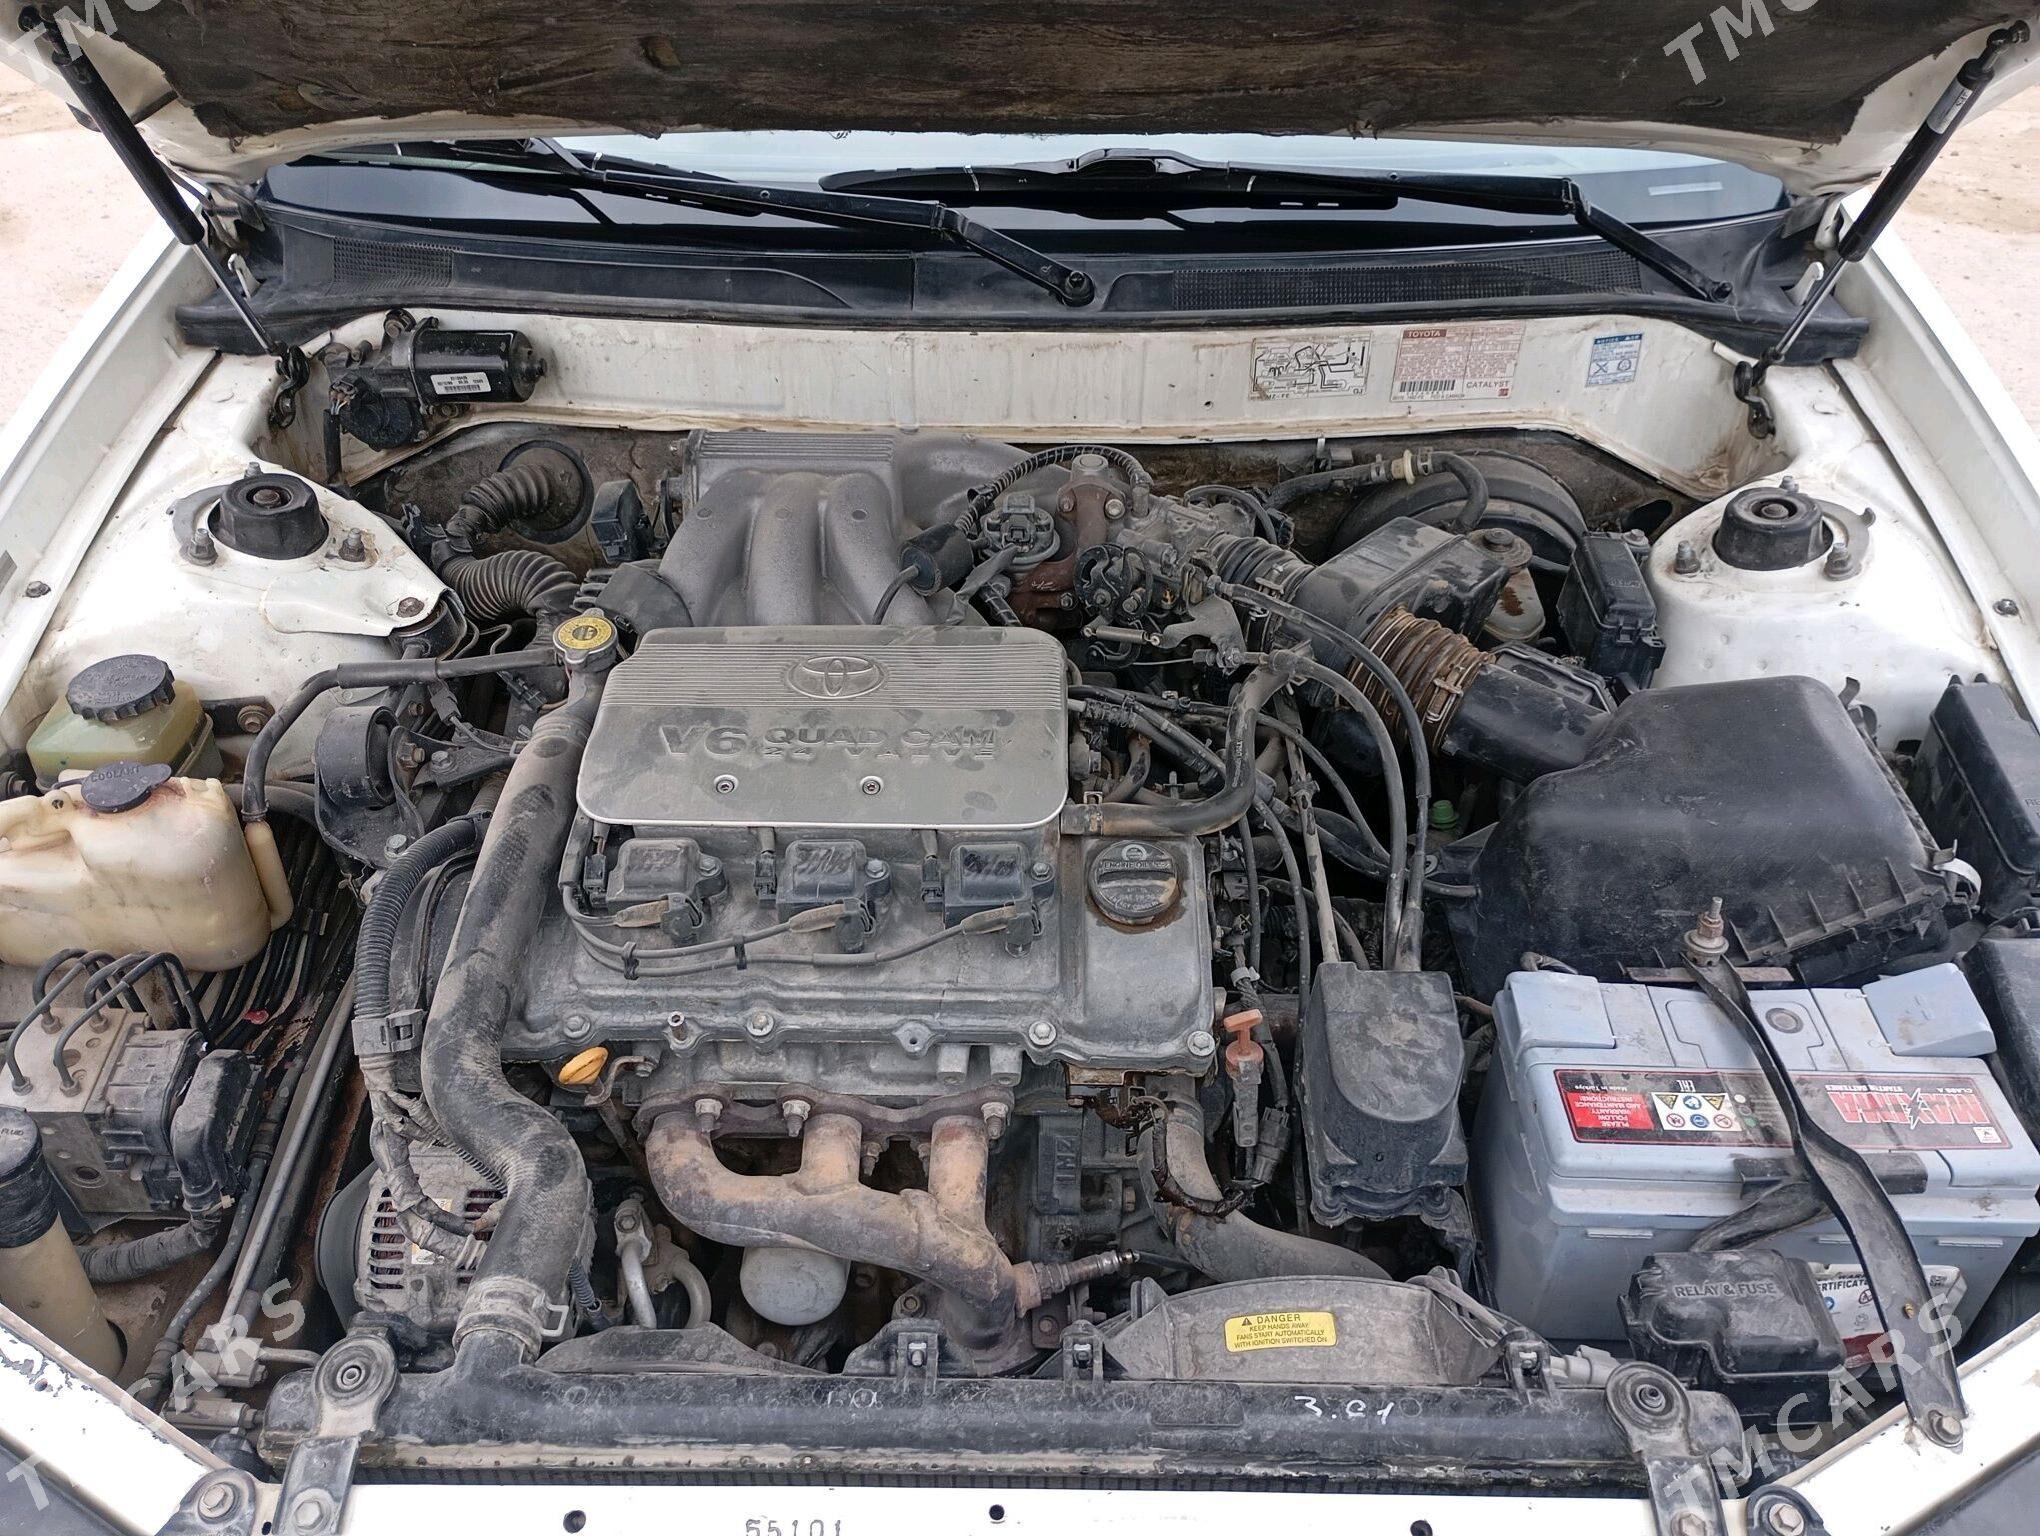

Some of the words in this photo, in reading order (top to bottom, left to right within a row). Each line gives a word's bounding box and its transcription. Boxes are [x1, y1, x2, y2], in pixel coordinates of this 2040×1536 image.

[1407, 330, 1441, 338] TOYOTA
[1466, 380, 1511, 389] CATALYST
[658, 724, 749, 758] V6
[763, 726, 889, 746] QUAD
[901, 725, 998, 747] CAM
[90, 764, 141, 783] COOLANT
[1674, 1284, 1720, 1297] RELAY
[1723, 1283, 1736, 1296] &
[1737, 1282, 1777, 1295] FUSE
[1256, 1313, 1301, 1324] DANGER
[1249, 1324, 1267, 1332] KEEP
[1267, 1323, 1290, 1331] HANDS
[1254, 1331, 1274, 1339] START
[1274, 1329, 1325, 1337] AUTOMATICALLY
[1251, 1338, 1280, 1347] IGNITION
[1281, 1336, 1316, 1344] SWITCHED
